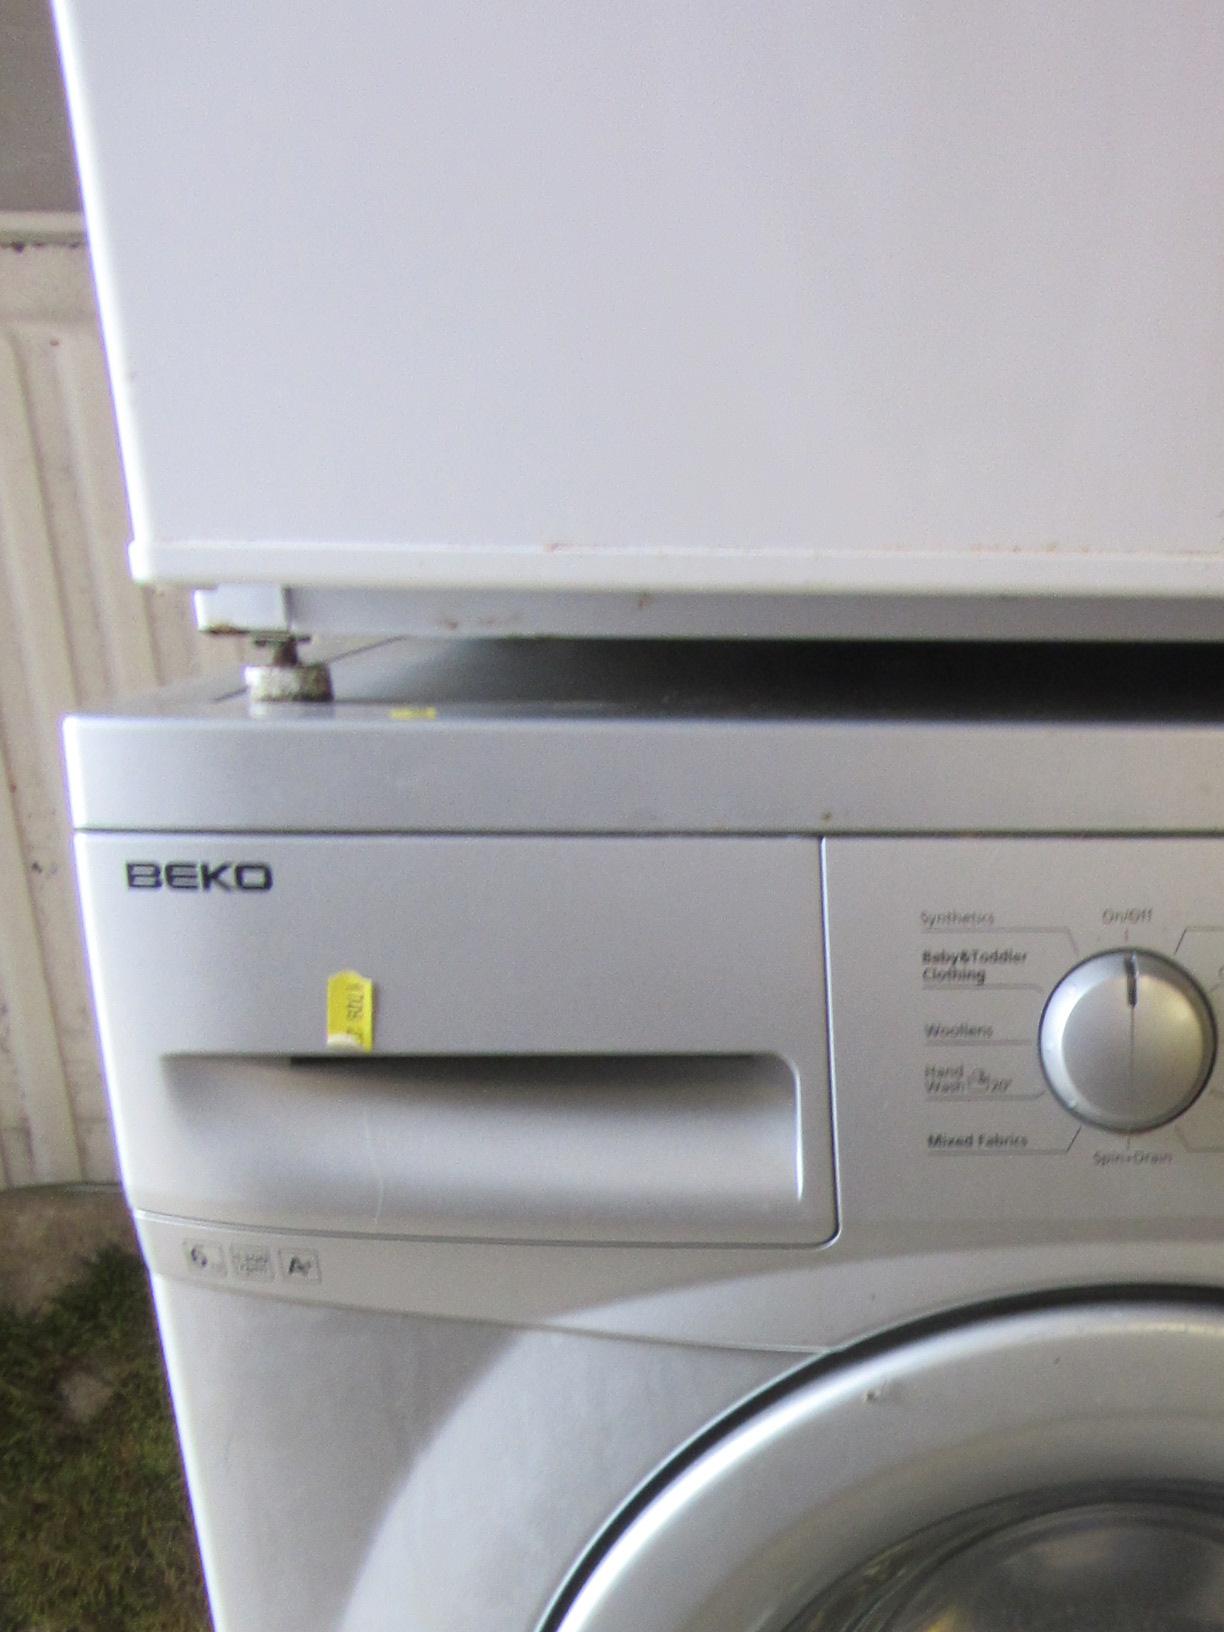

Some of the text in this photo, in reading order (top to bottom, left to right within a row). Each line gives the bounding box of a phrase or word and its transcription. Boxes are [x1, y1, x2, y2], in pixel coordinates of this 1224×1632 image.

[126, 863, 273, 891] BEKO
[922, 967, 987, 986] Clothing
[928, 1131, 1029, 1149] Mixed Fabrics
